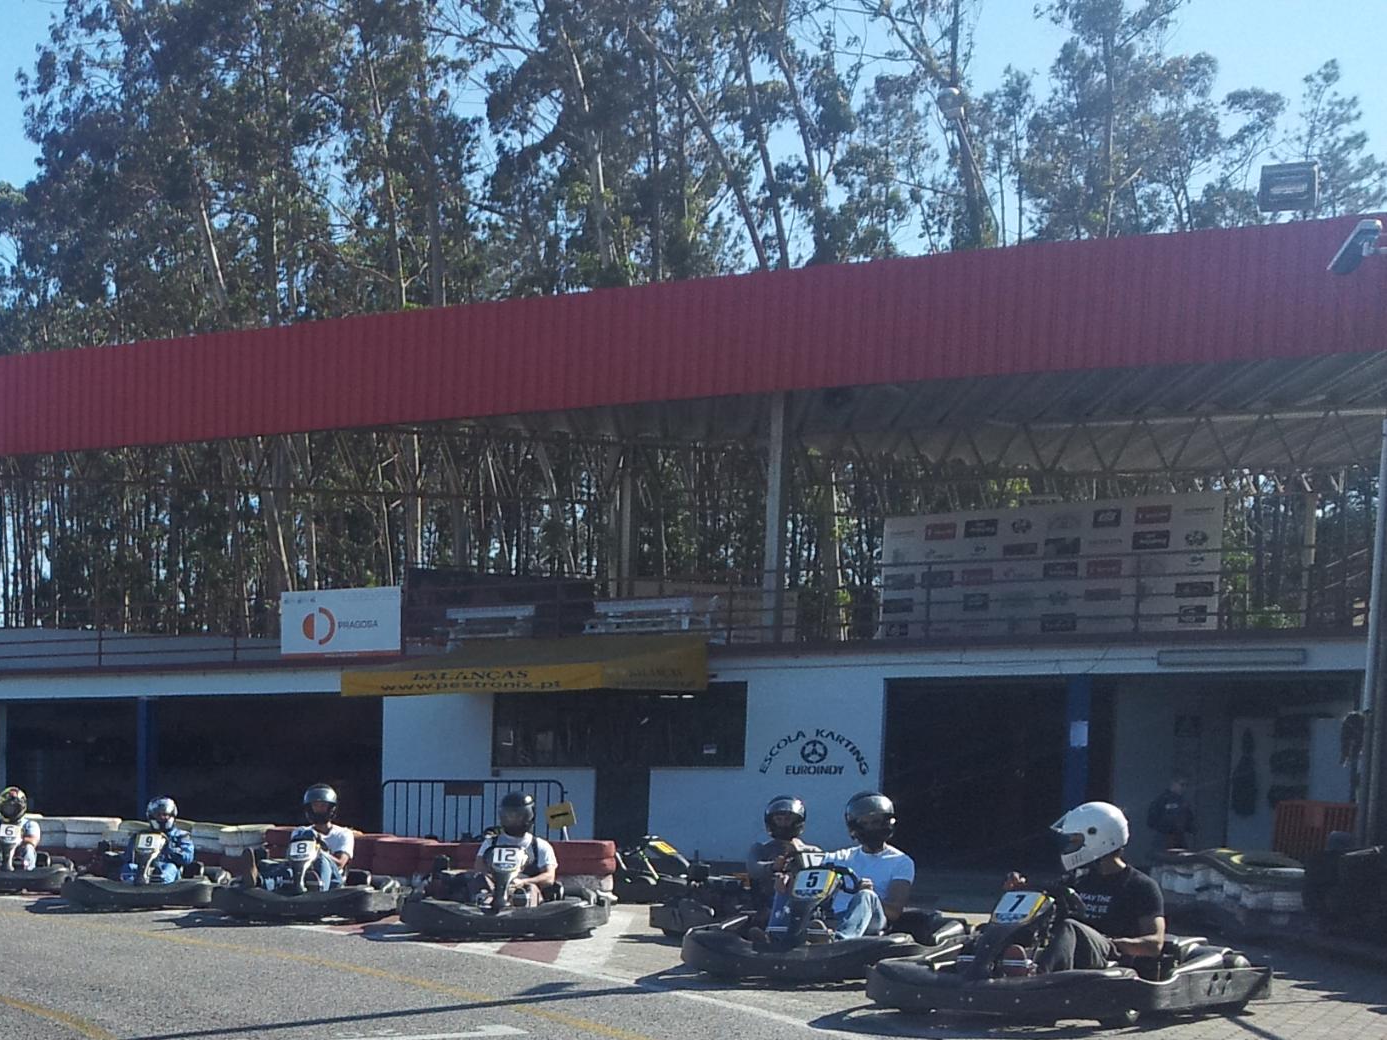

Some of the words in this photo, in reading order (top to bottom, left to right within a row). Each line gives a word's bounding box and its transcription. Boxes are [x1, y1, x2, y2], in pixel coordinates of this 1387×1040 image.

[337, 620, 379, 629] PRAGOSA
[759, 730, 807, 774] ESCOLA
[815, 728, 870, 776] KARTING
[785, 765, 845, 775] EUROINDY
[4, 825, 14, 836] 6
[145, 835, 154, 848] 9
[296, 842, 308, 854] 8
[497, 848, 517, 862] 12
[806, 871, 820, 888] 5
[1008, 894, 1027, 912] 7
